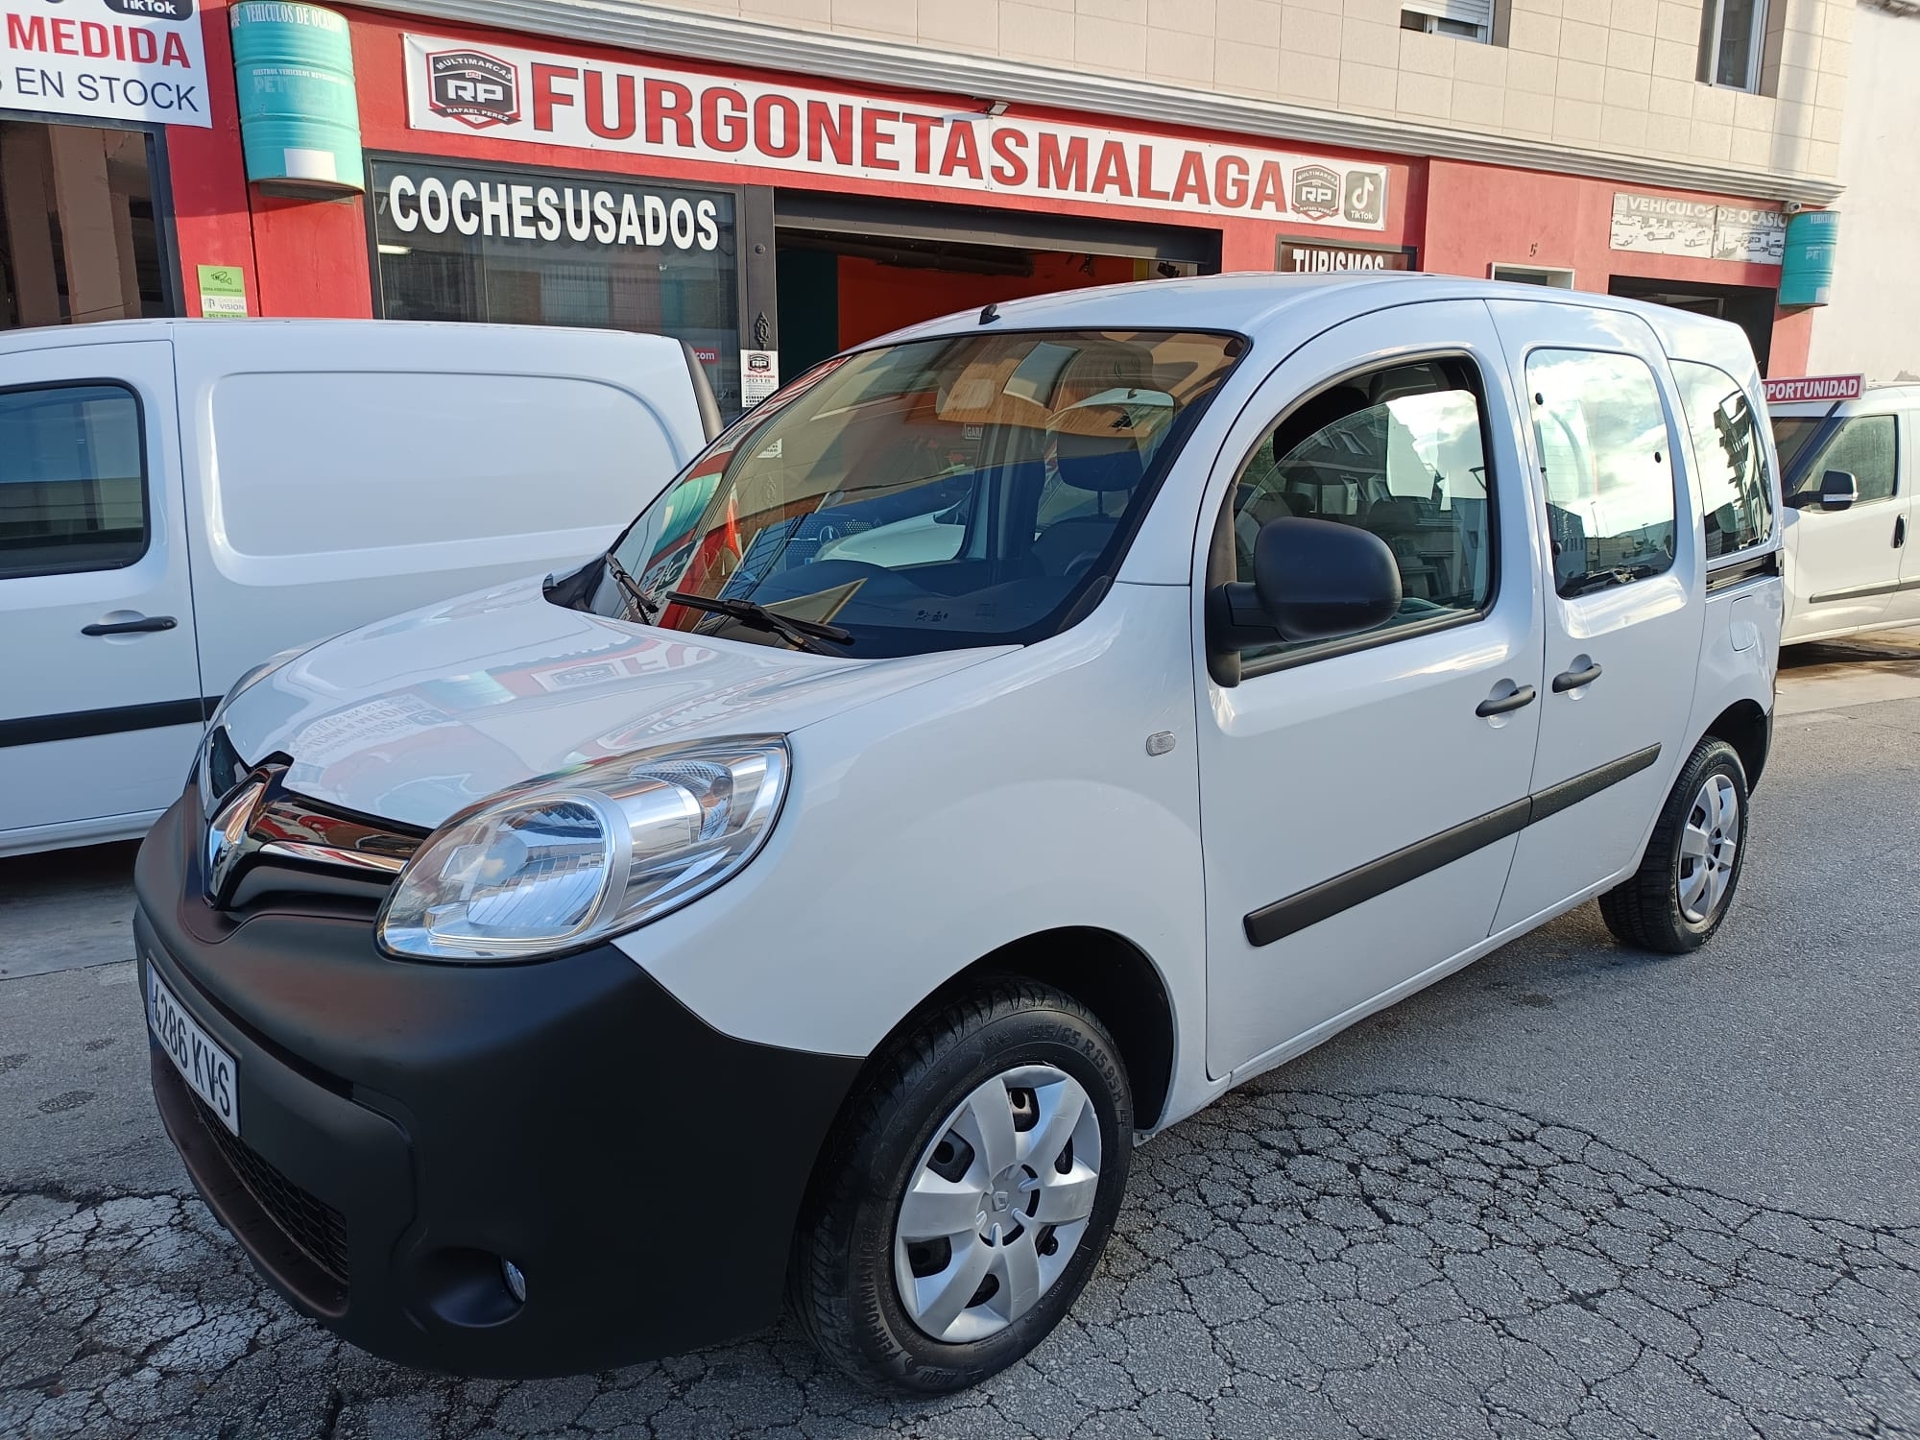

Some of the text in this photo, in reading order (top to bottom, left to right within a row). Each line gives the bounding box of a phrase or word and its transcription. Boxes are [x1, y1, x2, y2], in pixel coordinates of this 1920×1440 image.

[122, 0, 177, 15] TikTok
[246, 4, 294, 23] VEHICULOS
[296, 7, 310, 25] DE
[6, 13, 192, 69] MEDIDA
[435, 58, 513, 80] MULTIMARCAS
[15, 67, 199, 112] EN STOCK
[447, 79, 504, 103] RP
[481, 110, 509, 122] PEREZ
[531, 61, 1288, 214] FURGONETASMALAGA
[1301, 186, 1332, 203] RP
[389, 175, 719, 251] COCHESUSADOS
[1351, 210, 1374, 221] TikTok
[1629, 197, 1716, 219] VEHICULOS
[1717, 208, 1736, 222] DE
[153, 984, 230, 1118] 4286 KVS
